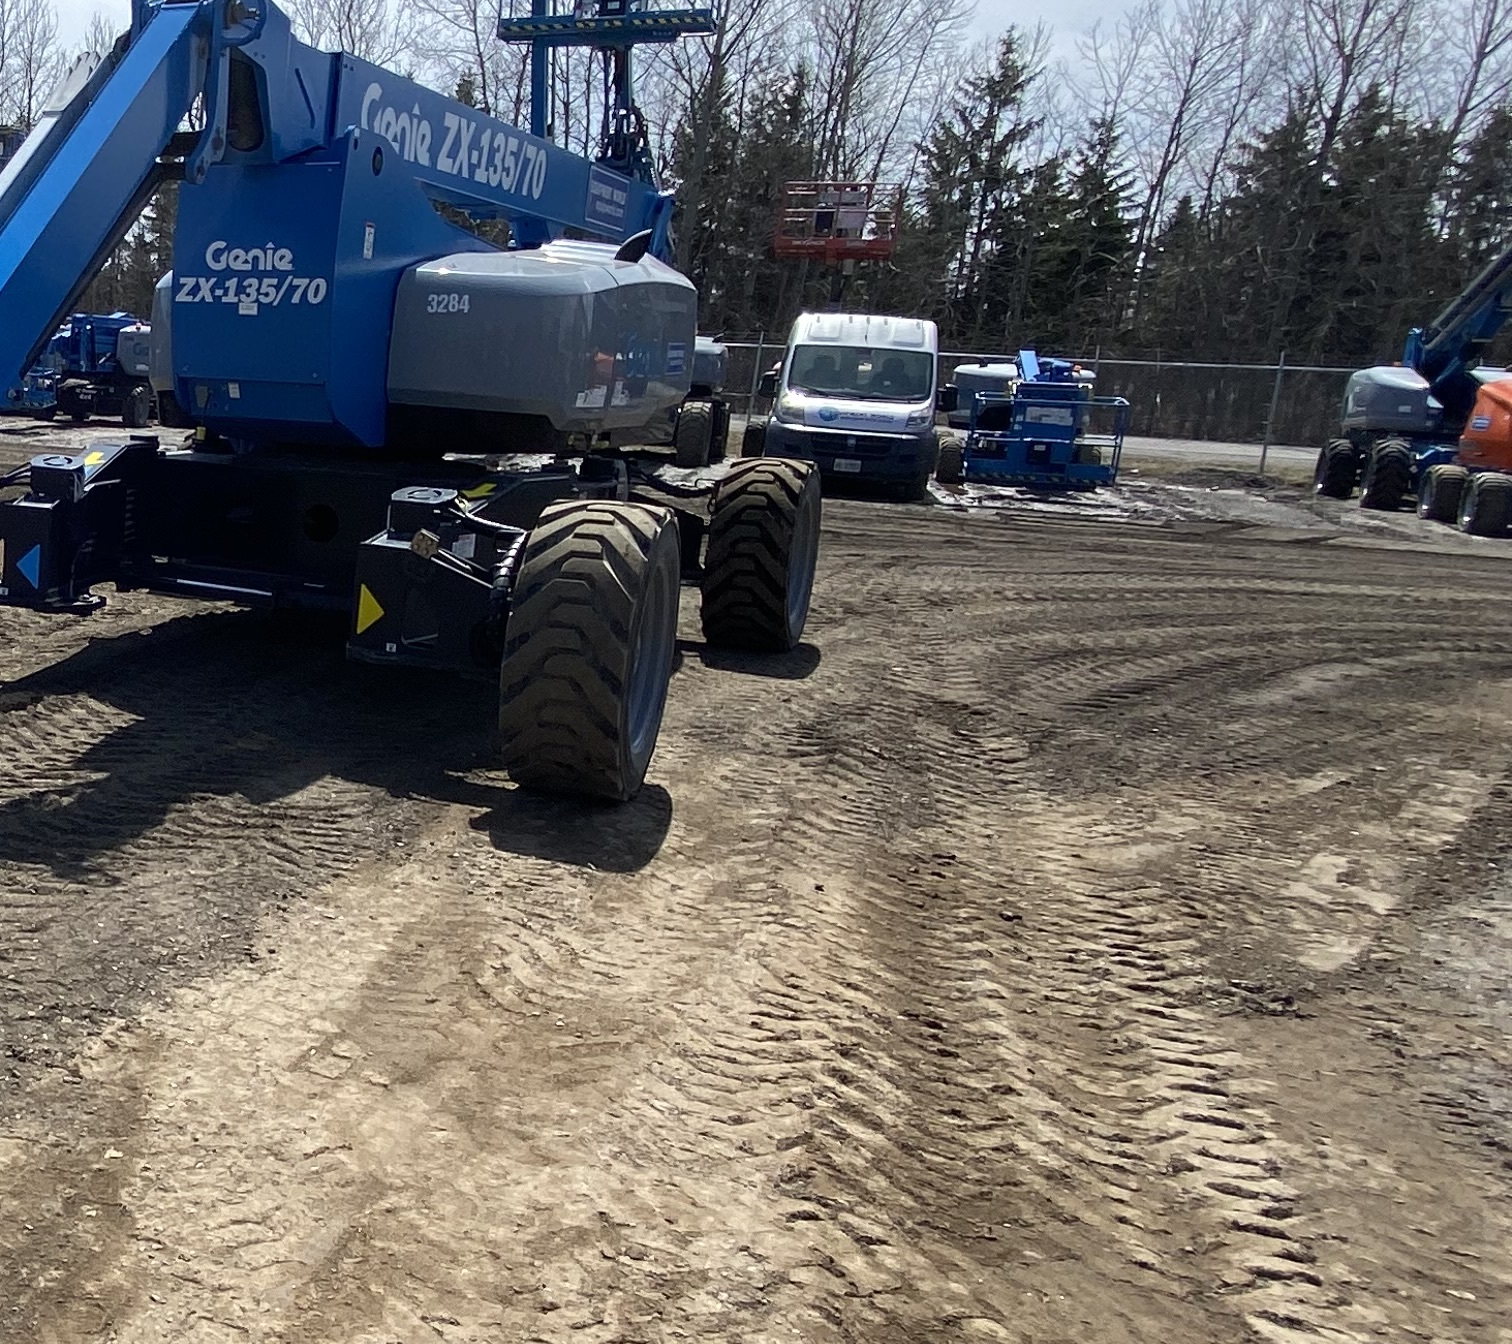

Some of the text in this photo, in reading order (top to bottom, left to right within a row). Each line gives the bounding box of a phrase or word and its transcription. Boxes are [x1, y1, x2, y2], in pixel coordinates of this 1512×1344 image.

[436, 111, 548, 201] ZX-135/70
[205, 240, 294, 272] Genie
[174, 274, 328, 307] ZX-135/70
[426, 293, 471, 314] 3284
